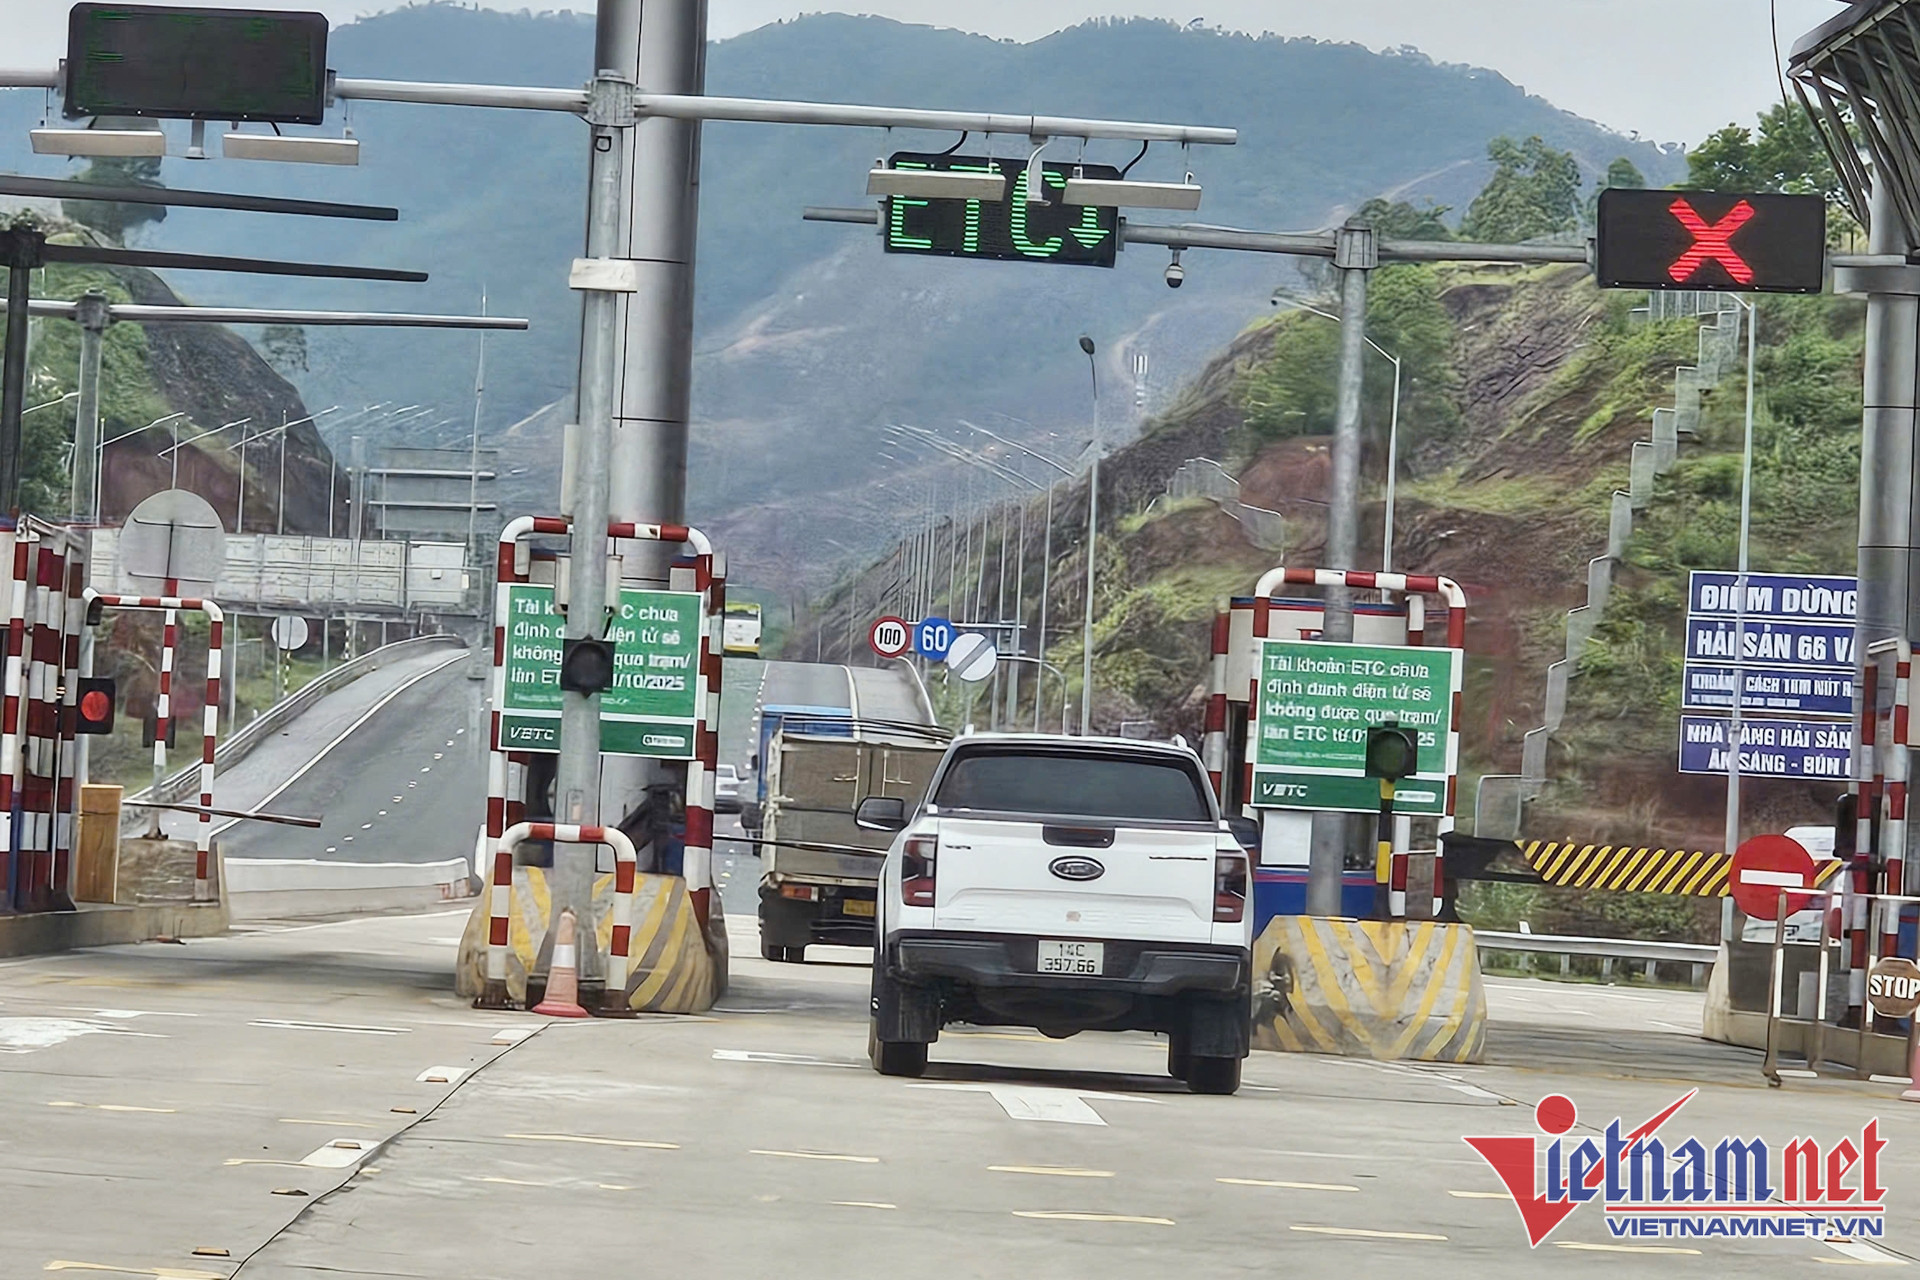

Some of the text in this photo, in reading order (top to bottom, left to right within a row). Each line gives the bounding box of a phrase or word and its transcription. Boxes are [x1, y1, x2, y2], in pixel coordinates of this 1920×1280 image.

[890, 161, 1067, 257] ETC
[514, 598, 540, 615] Tài
[638, 606, 679, 621] chưa
[1782, 584, 1857, 615] DỪNG
[513, 621, 550, 641] định
[641, 626, 660, 644] tử
[879, 627, 901, 646] 100
[922, 625, 948, 652] 60
[1697, 622, 1735, 655] HẢI
[1743, 624, 1791, 659] SẢN
[512, 644, 563, 666] không
[614, 653, 645, 670] qua
[1266, 654, 1429, 679] Tài khoản ETC chưa
[541, 669, 561, 684] ET
[613, 673, 685, 691] 1/10/2025
[1266, 678, 1303, 696] định
[1307, 682, 1347, 697] danh
[1352, 682, 1387, 701] điện
[1265, 700, 1442, 726] không được qu trạm/
[510, 726, 555, 741] VETC
[1293, 725, 1327, 741] ETC
[1687, 722, 1723, 743] NHÀ
[1780, 723, 1811, 748] HẢI
[1815, 725, 1852, 750] SẢN
[1739, 750, 1786, 773] SÁNG
[1803, 753, 1840, 776] BÚN
[1262, 782, 1308, 798] VETC
[1870, 974, 1920, 1000] STOP
